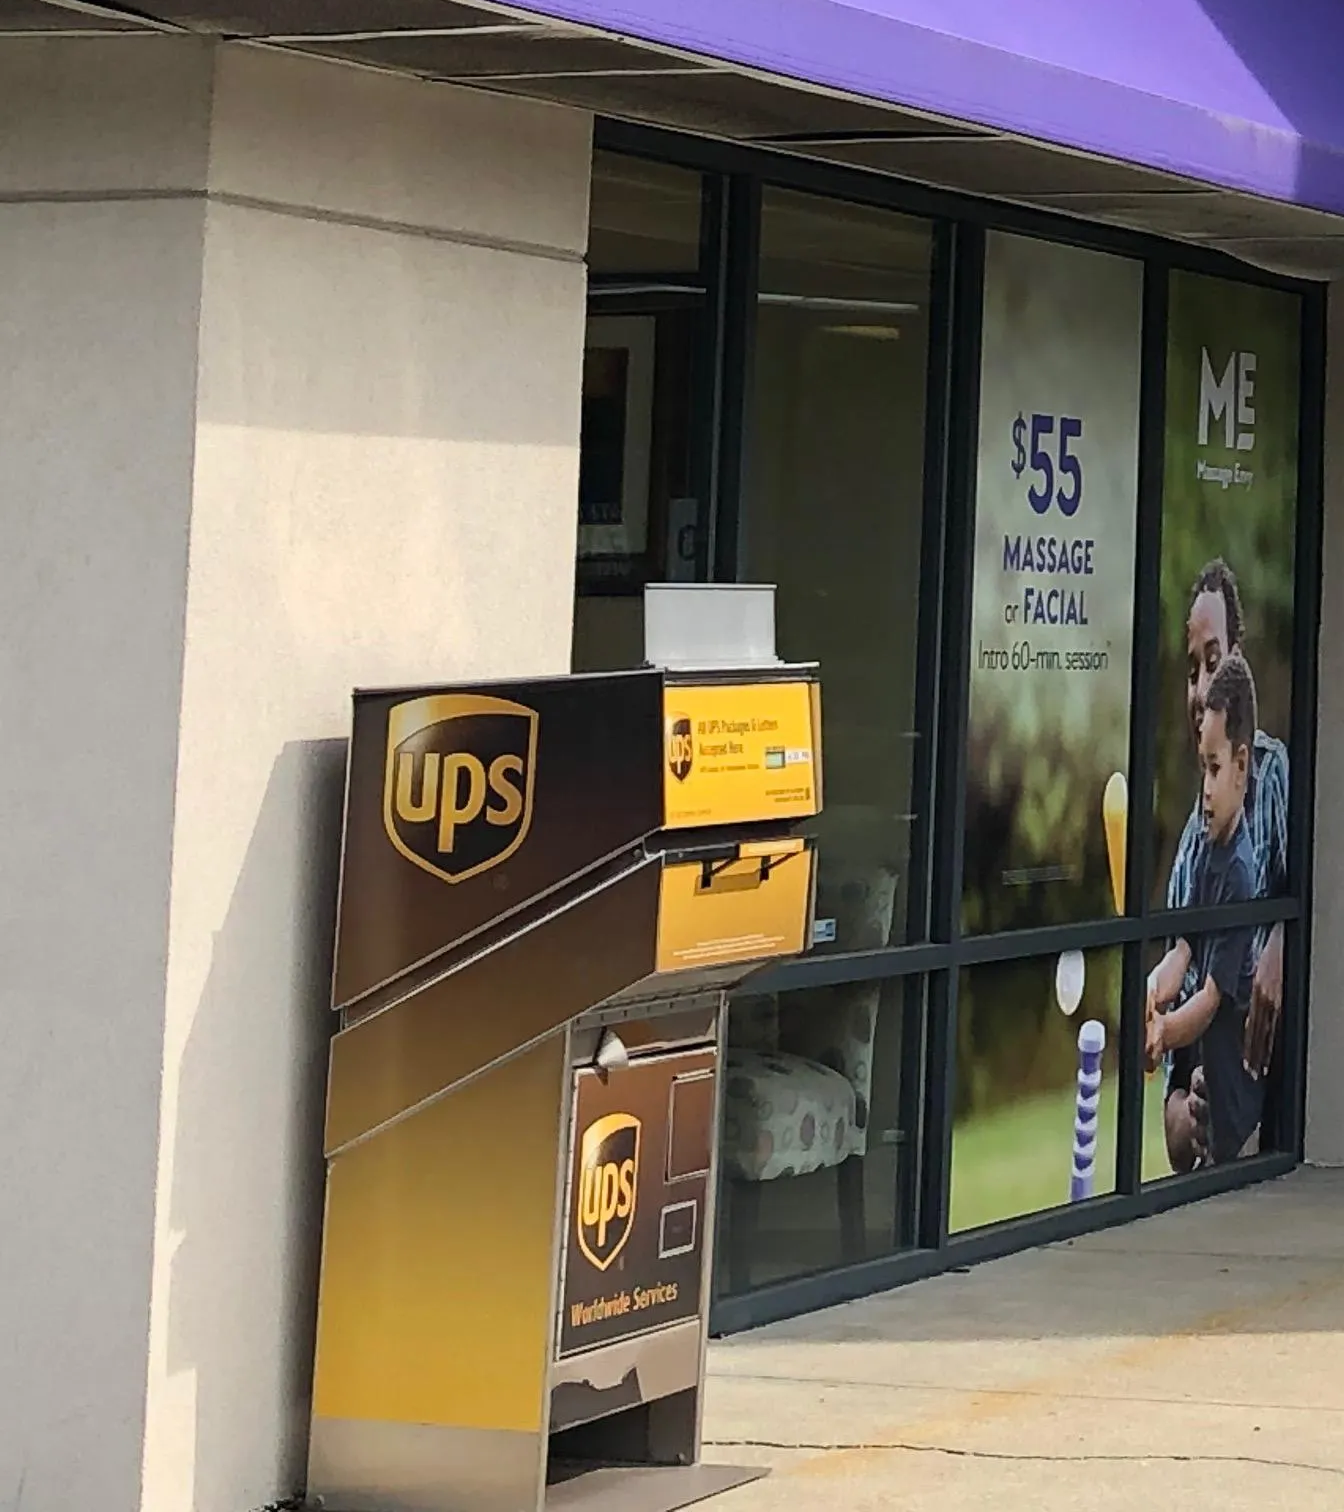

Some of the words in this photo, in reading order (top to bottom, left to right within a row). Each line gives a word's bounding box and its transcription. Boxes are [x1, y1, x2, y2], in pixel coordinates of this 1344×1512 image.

[1197, 344, 1258, 449] ME
[1010, 410, 1083, 517] $55
[1002, 534, 1095, 576] MASSAGE
[1004, 601, 1018, 623] or
[1022, 588, 1089, 626] FACIAL
[978, 639, 1010, 670] Intro
[670, 733, 692, 775] ups
[395, 751, 525, 854] ups
[581, 1157, 636, 1247] ups
[570, 1293, 632, 1328] Worldwide
[632, 1280, 679, 1313] Services
